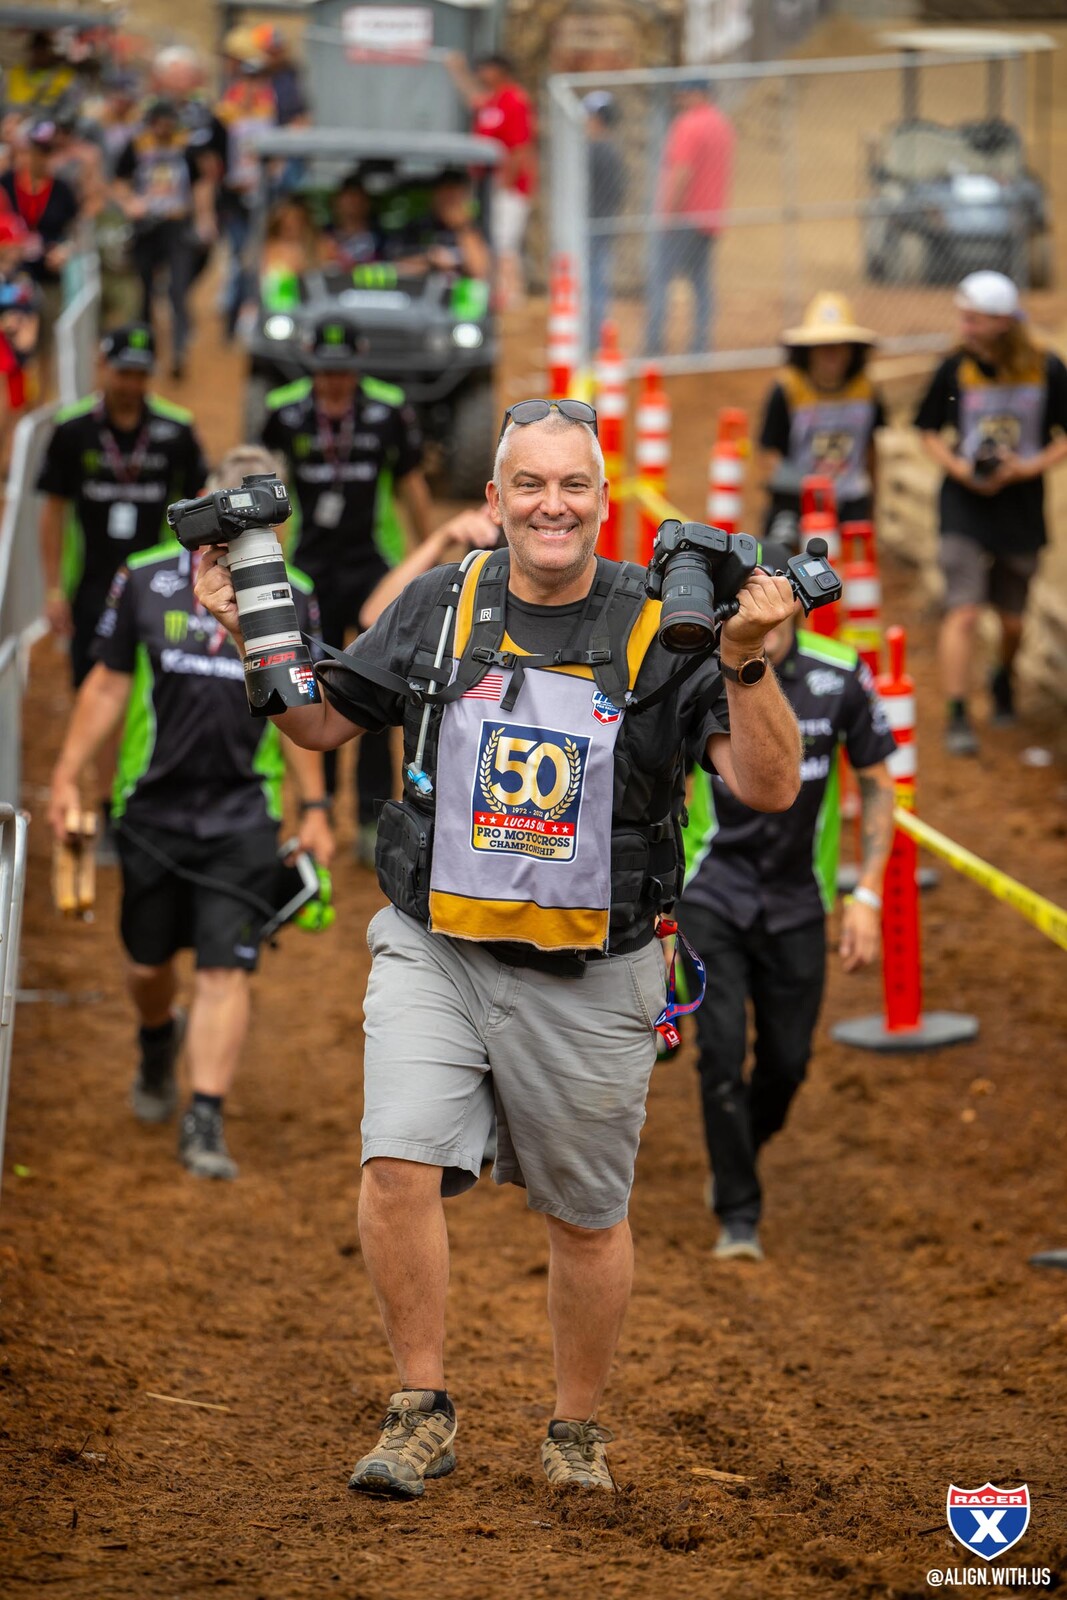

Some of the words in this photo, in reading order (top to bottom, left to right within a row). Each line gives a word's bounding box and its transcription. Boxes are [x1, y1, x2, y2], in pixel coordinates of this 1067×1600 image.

[490, 736, 571, 810] 50
[512, 806, 527, 815] 1972
[503, 816, 537, 830] LUCAS
[536, 821, 546, 832] OIL
[477, 826, 501, 838] PRO
[504, 829, 571, 848] MOTOCROSS
[489, 840, 556, 856] CHAMPIONSHIP
